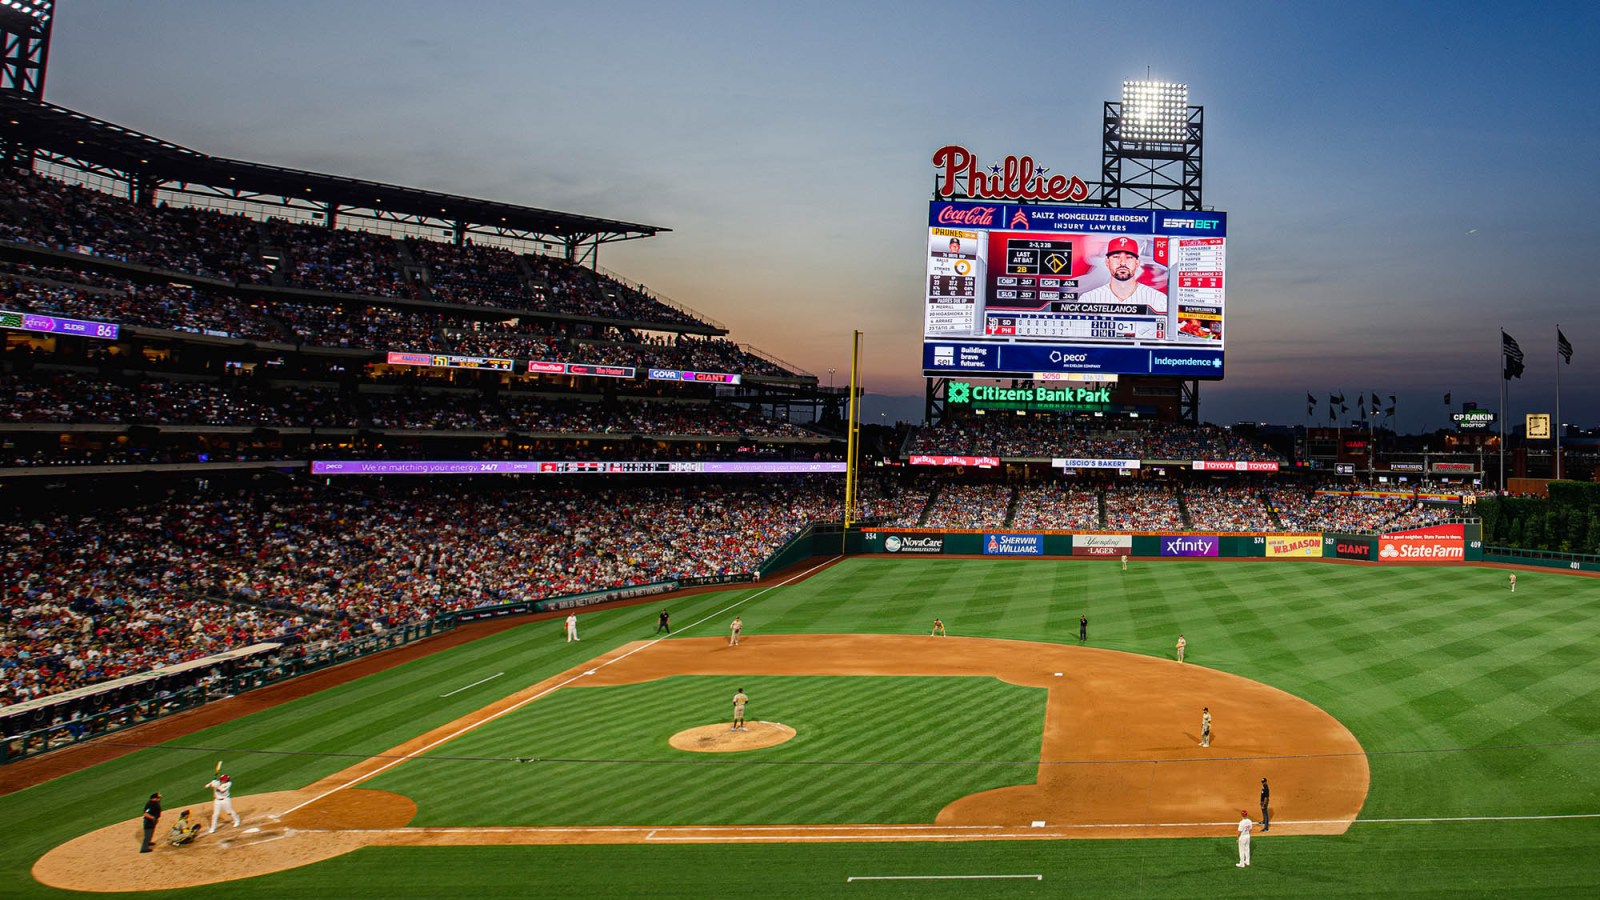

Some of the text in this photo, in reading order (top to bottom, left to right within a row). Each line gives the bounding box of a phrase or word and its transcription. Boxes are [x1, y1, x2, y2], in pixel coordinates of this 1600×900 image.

[932, 145, 1088, 201] Phillies
[938, 205, 997, 226] Coca-Cola
[1031, 211, 1150, 224] SALTZ MONGELUZZI BENDESKY
[1053, 222, 1127, 231] INJURY LAWYERS
[1061, 303, 1138, 313] NICK CASTELLANOS
[63, 323, 86, 331] SLIDER
[96, 325, 112, 337] 86
[1117, 322, 1134, 331] 0-1
[960, 346, 987, 355] Building
[1063, 354, 1086, 363] peco
[1154, 356, 1212, 367] Independence
[652, 371, 676, 379] GOYA
[695, 373, 725, 382] GIANT
[972, 386, 1110, 402] Citizens Bank Park
[1465, 413, 1494, 421] RANKIN
[912, 455, 936, 465] JIM BEAM
[952, 456, 967, 466] BEAM
[983, 456, 997, 466] BEAM
[361, 463, 386, 471] We're
[388, 463, 428, 472] matching
[430, 464, 449, 472] your
[450, 464, 478, 472] energy
[480, 463, 498, 471] 24/7
[901, 537, 943, 547] NovaCare
[1000, 535, 1037, 544] SHERWIN
[1083, 537, 1120, 546] Yuengling
[1166, 538, 1213, 555] xfinity
[1336, 544, 1370, 555] GIANT
[1470, 541, 1481, 549] 409
[1570, 562, 1580, 570] 401
[620, 585, 664, 599] MLB NETWORK
[559, 595, 609, 609] MLB NETWORK
